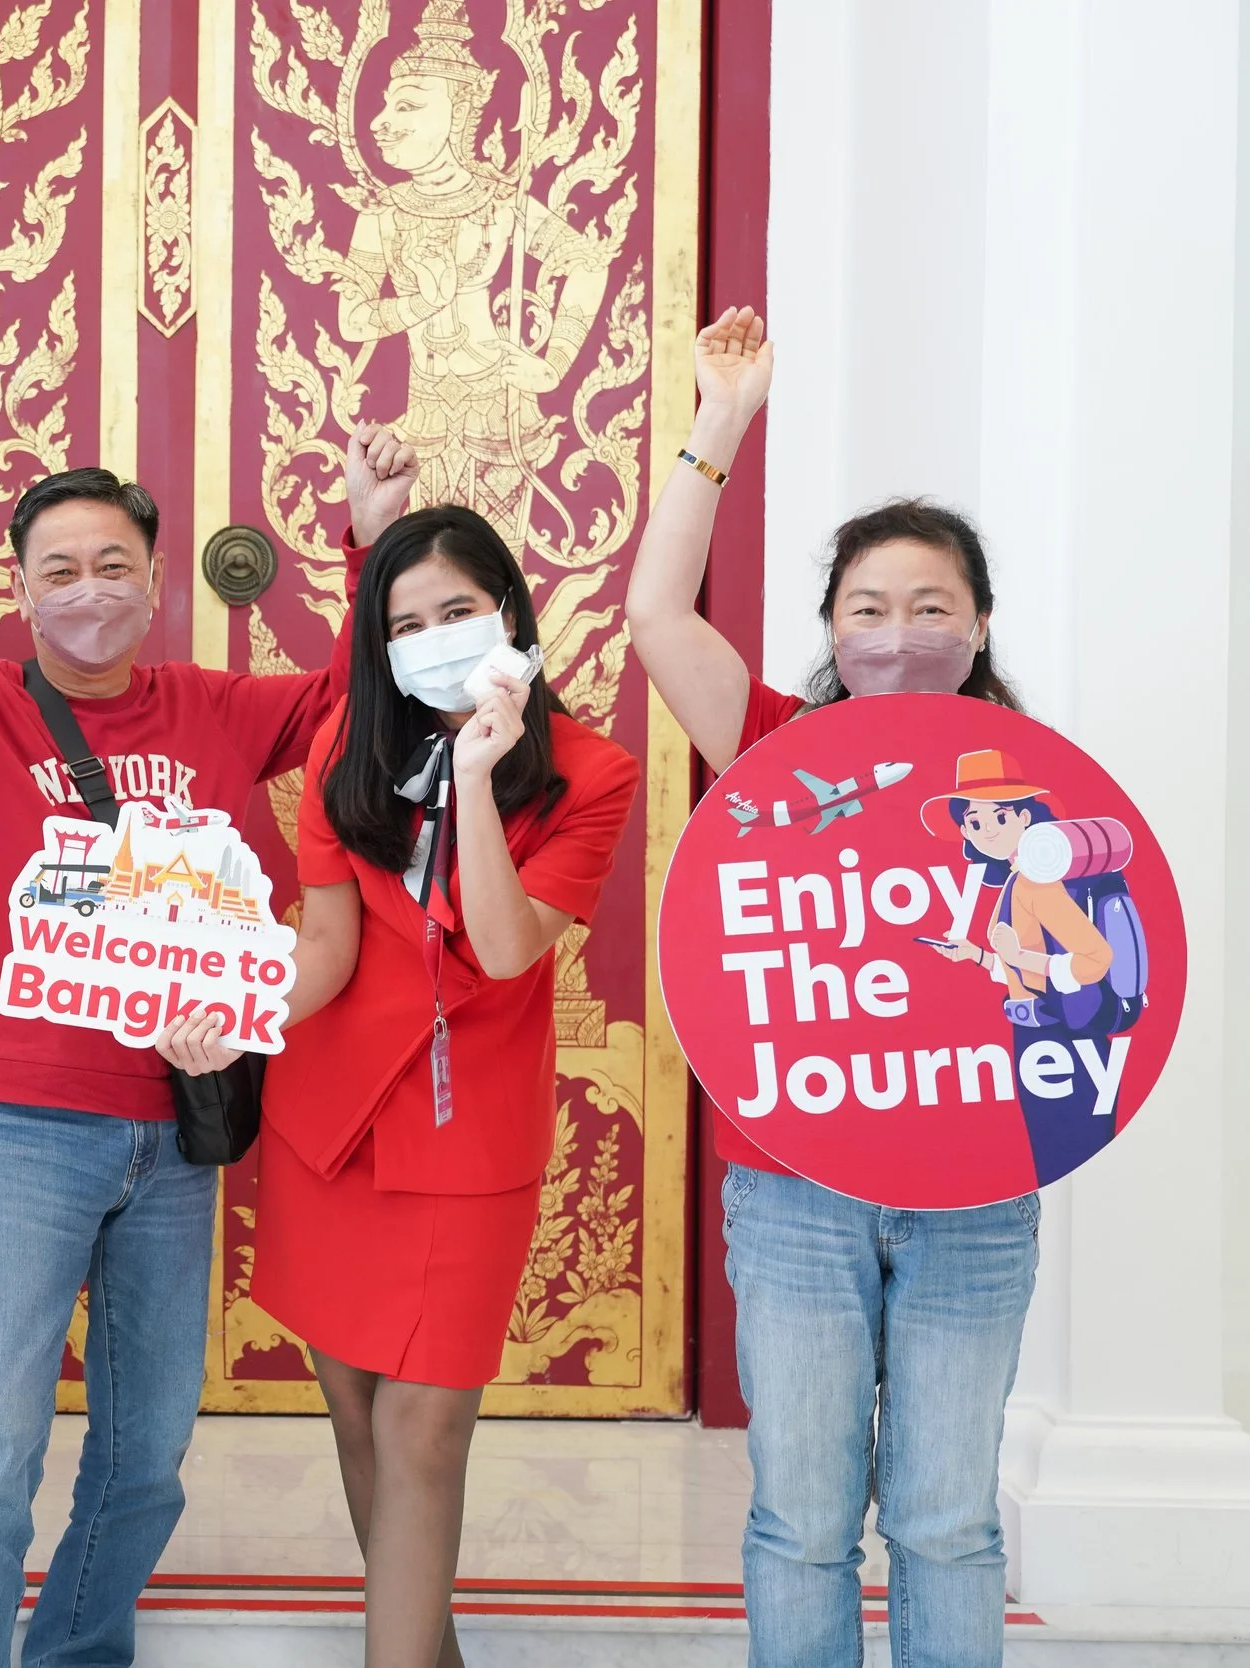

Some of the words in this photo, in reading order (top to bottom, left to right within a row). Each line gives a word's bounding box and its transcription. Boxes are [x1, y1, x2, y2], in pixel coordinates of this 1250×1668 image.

[108, 754, 197, 810] YORK
[427, 919, 436, 943] ALL
[717, 848, 988, 949] Enjoy
[19, 915, 226, 978] Welcome
[238, 950, 286, 986] to
[721, 942, 910, 1026] The
[737, 1036, 1132, 1119] Journey
